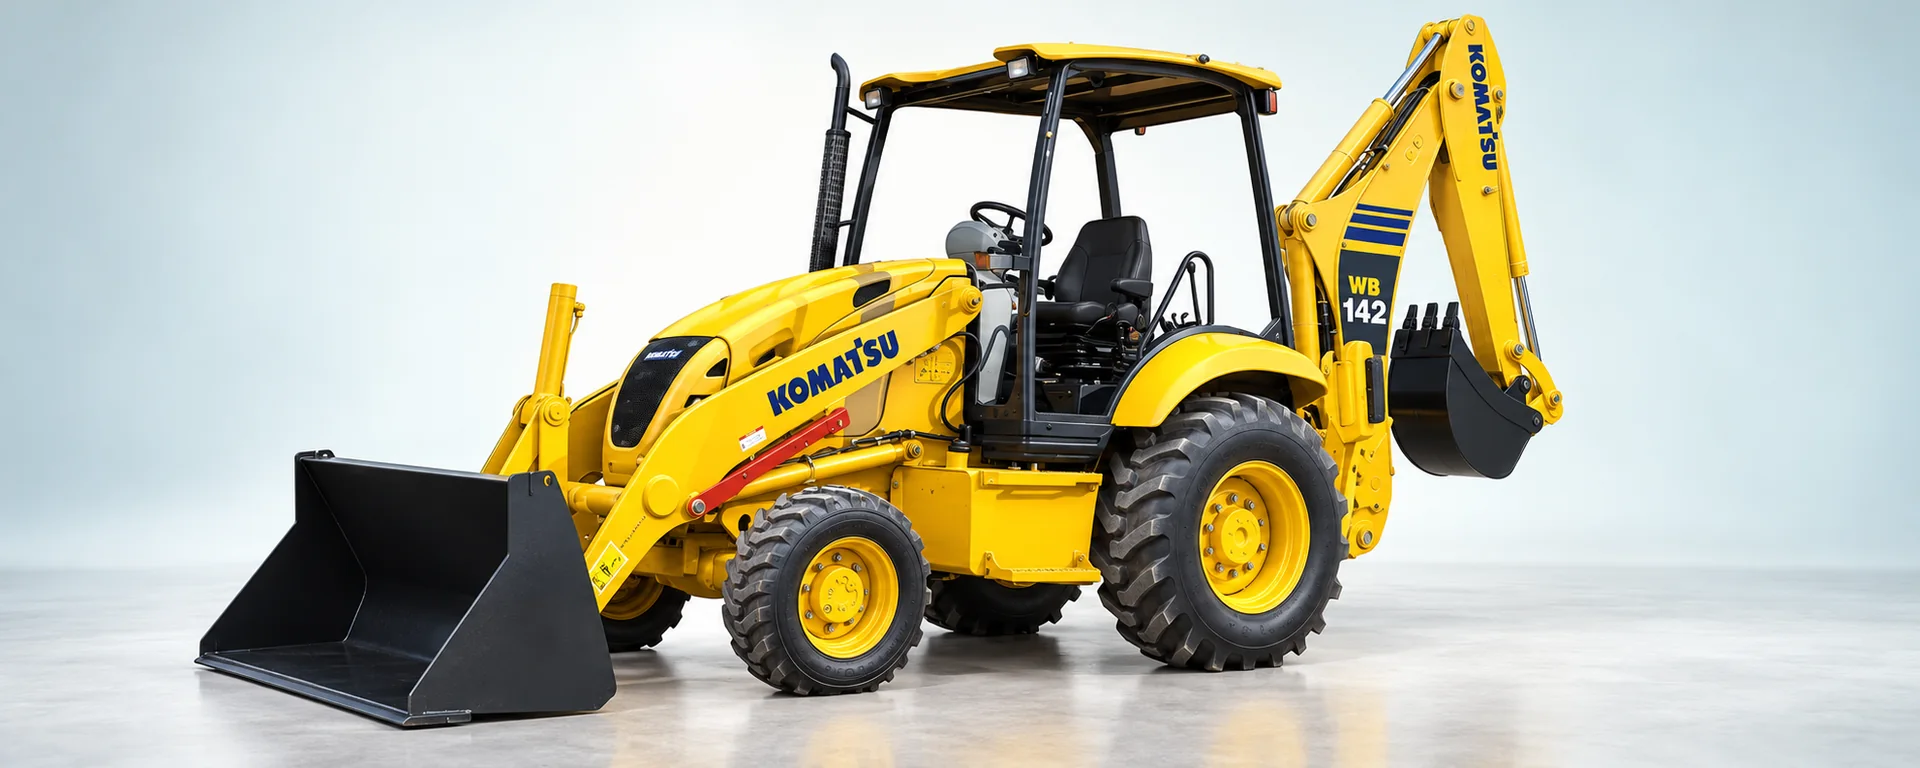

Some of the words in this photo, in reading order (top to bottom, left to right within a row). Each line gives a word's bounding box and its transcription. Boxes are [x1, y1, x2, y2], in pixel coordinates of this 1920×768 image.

[1468, 44, 1498, 171] KOMATSU
[1342, 297, 1387, 325] 142
[1348, 275, 1380, 296] WB
[766, 329, 899, 417] KOMATSU
